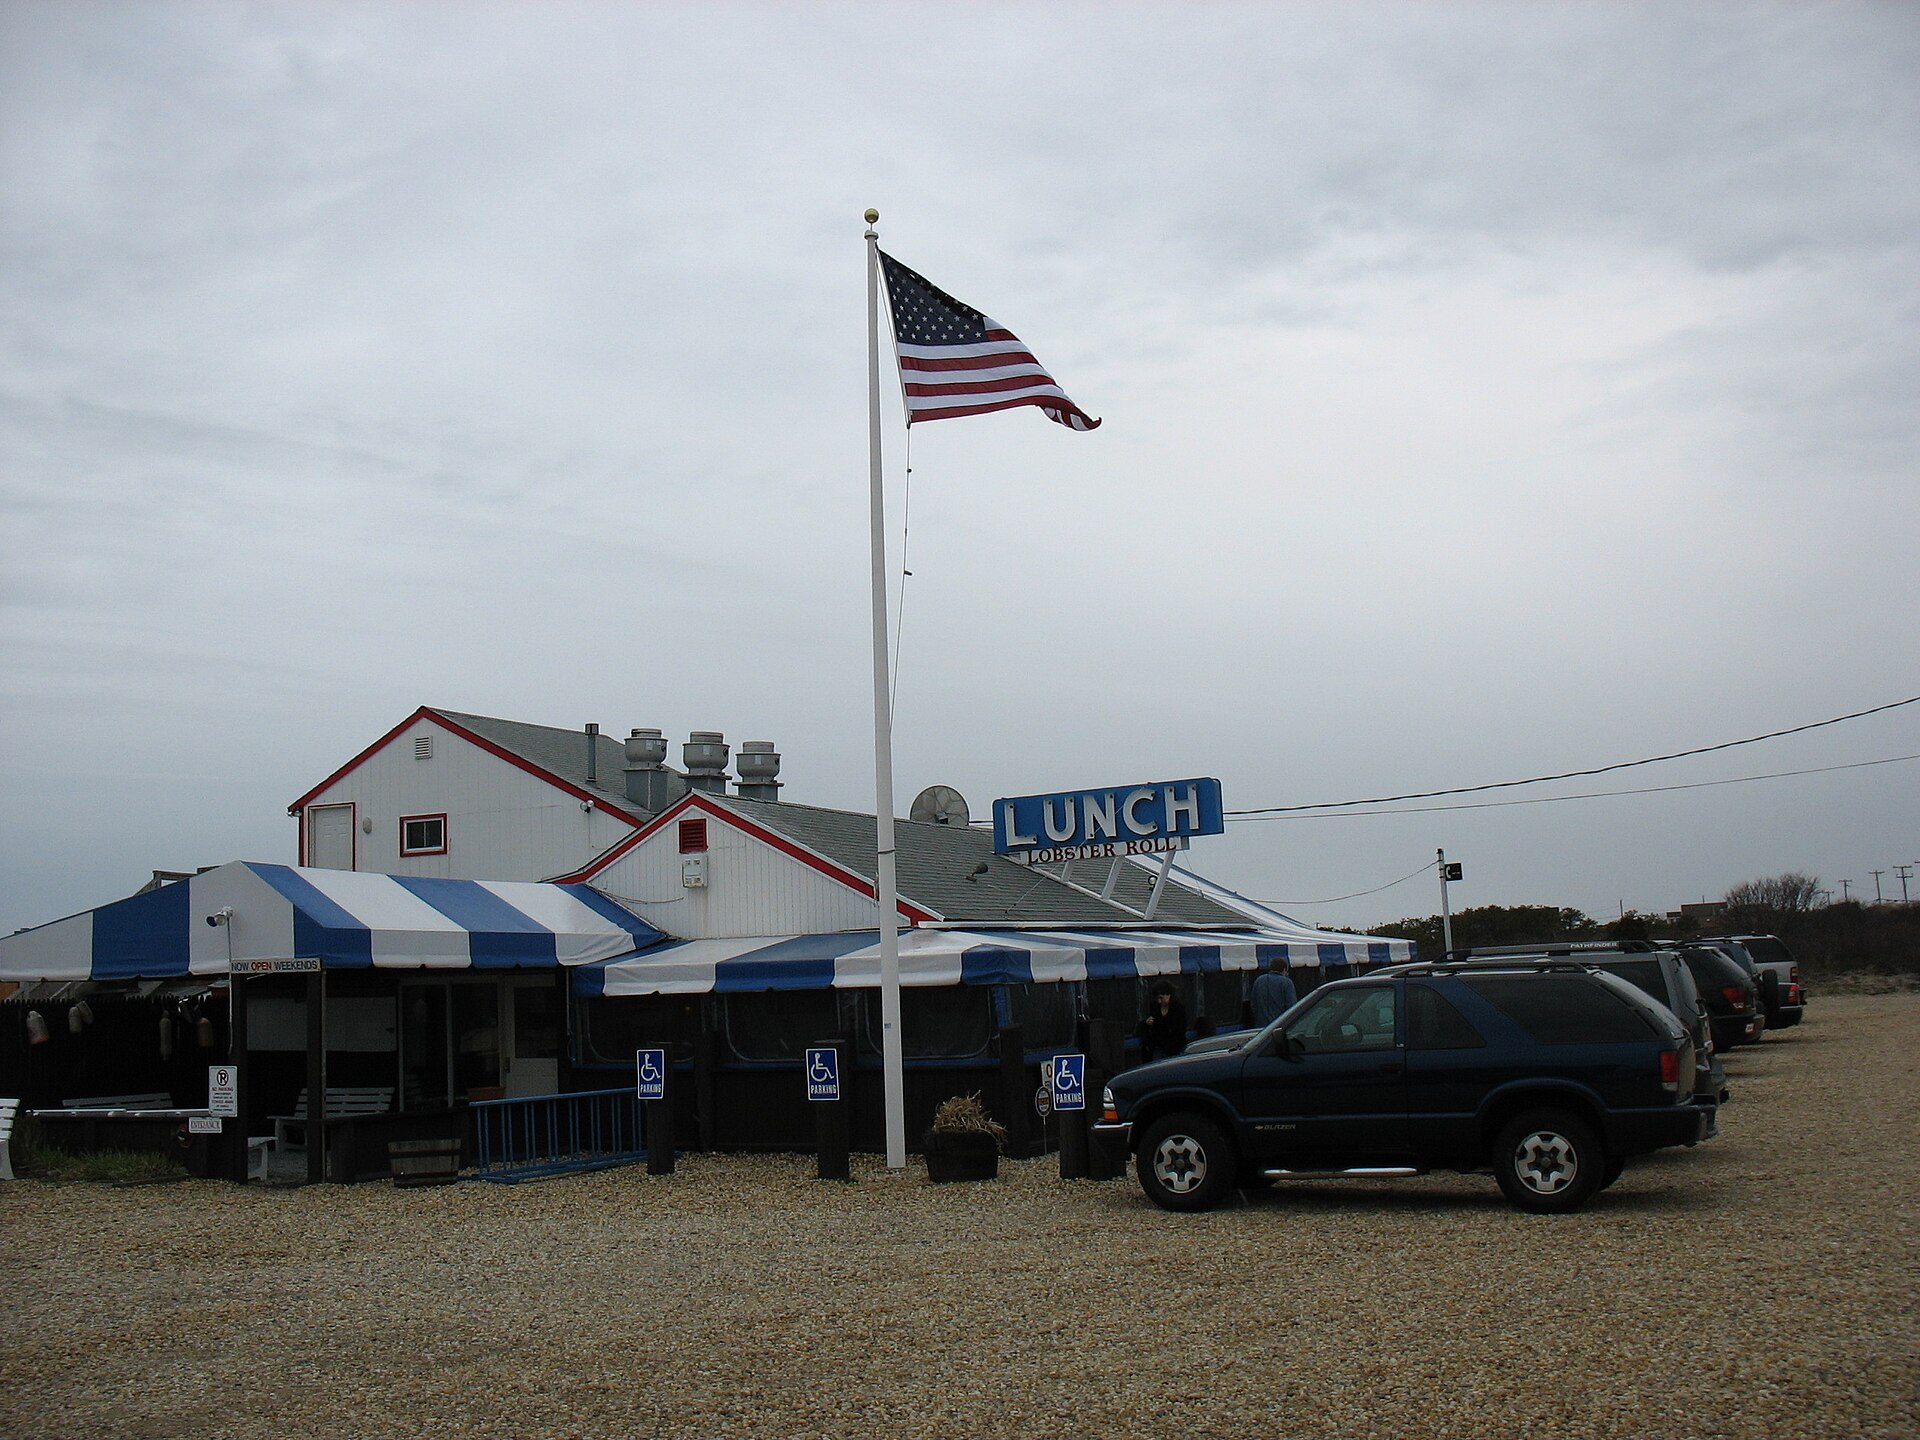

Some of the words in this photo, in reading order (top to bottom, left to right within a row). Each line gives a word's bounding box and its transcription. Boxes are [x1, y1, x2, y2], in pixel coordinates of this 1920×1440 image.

[1004, 783, 1199, 847] LUNCH
[1027, 843, 1115, 864] LOBSTER
[1126, 837, 1178, 854] ROLL
[231, 962, 249, 971] NOW
[251, 961, 272, 971] OPEN
[274, 960, 318, 971] WEEKENDS
[640, 1083, 662, 1094] PARKING
[810, 1084, 837, 1095] PARKING
[1056, 1093, 1082, 1104] PARKING
